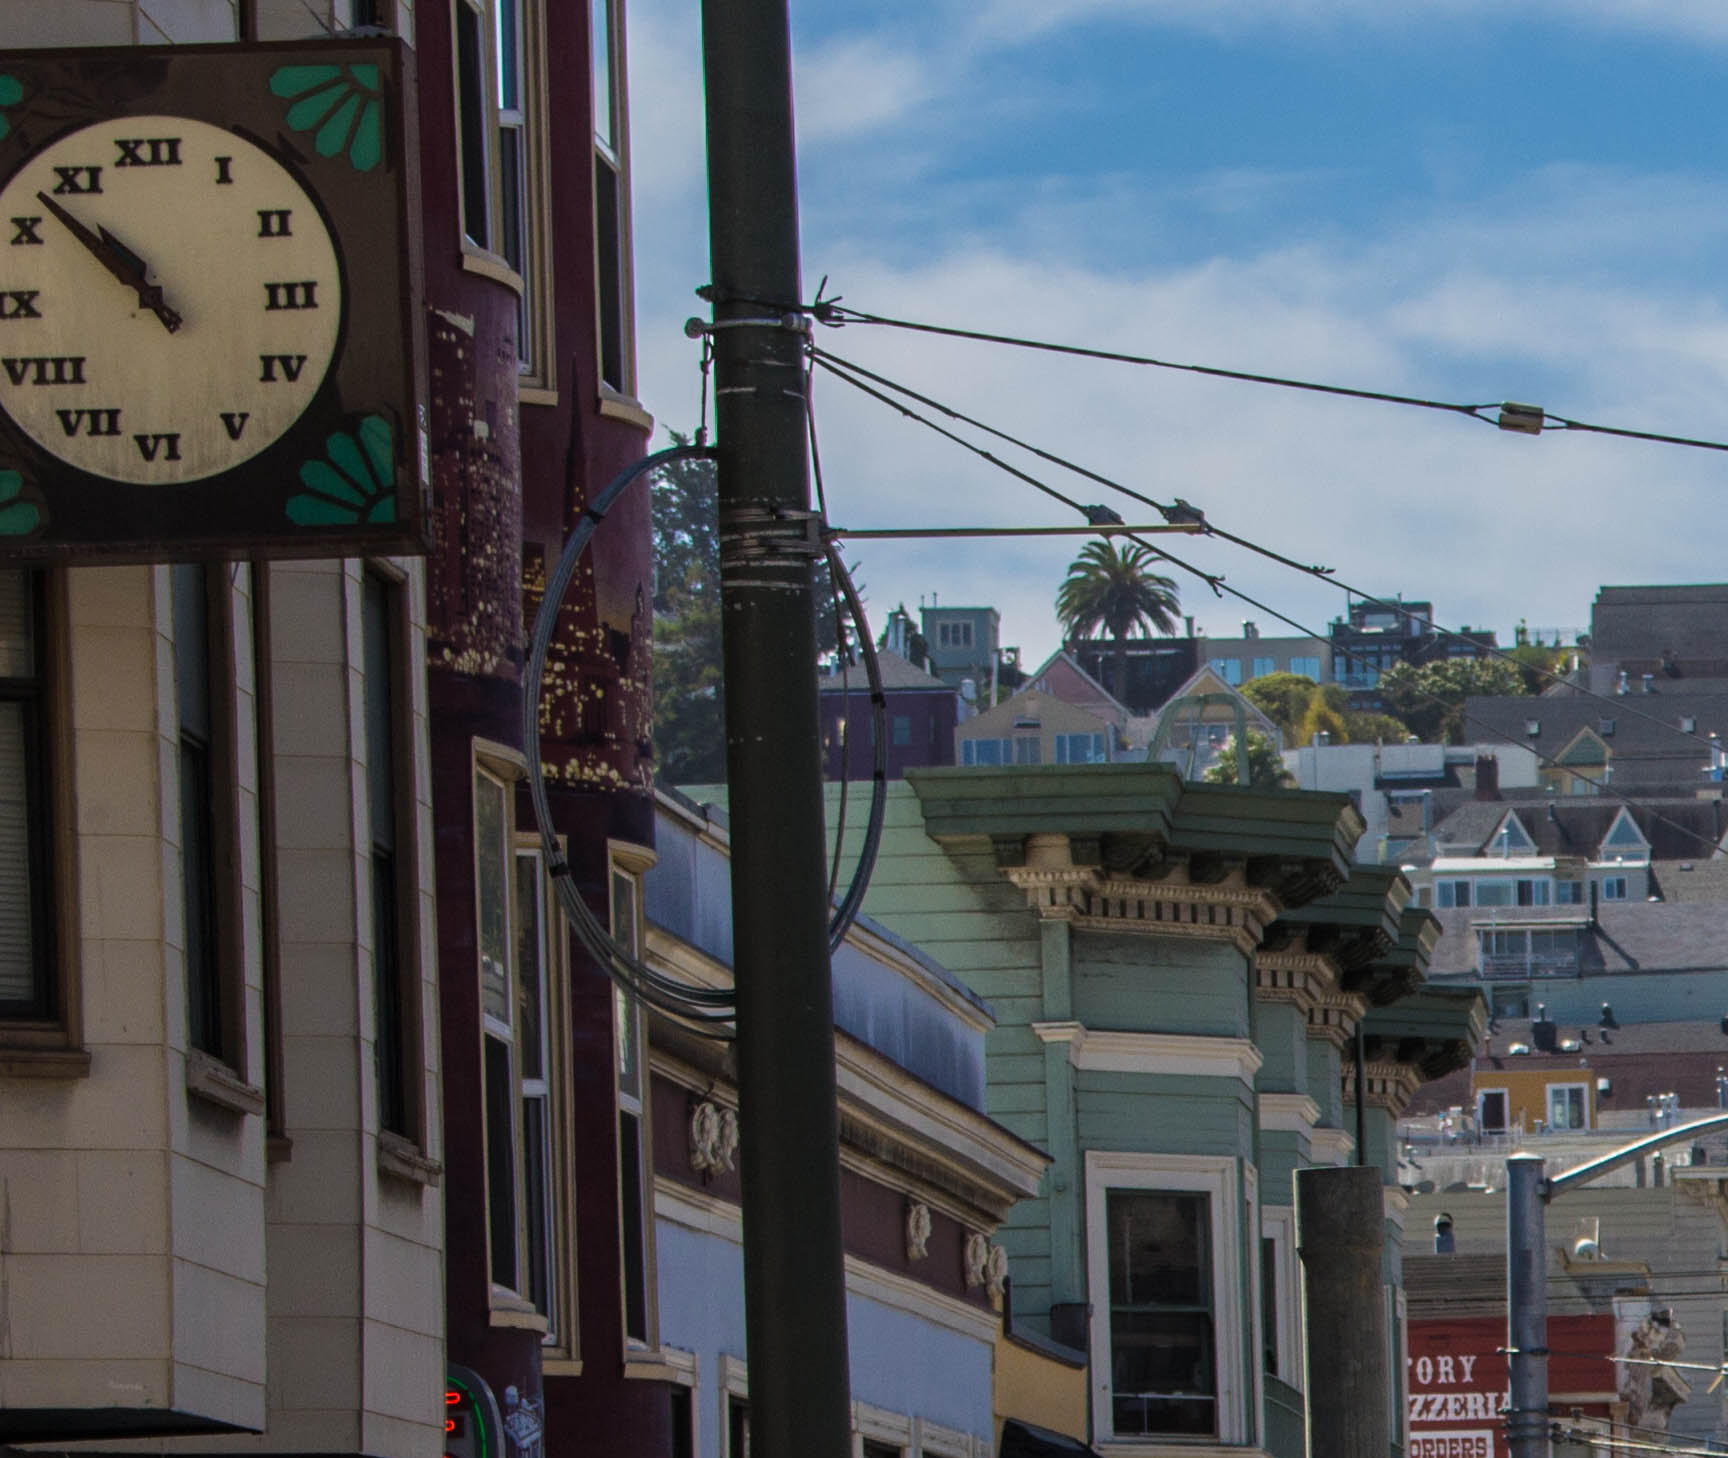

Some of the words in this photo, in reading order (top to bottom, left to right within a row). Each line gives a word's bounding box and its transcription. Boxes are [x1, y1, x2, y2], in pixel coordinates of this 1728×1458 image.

[114, 138, 182, 166] XII
[53, 166, 103, 194] XI
[215, 157, 233, 184] I
[10, 217, 43, 245] X
[257, 209, 292, 237] II
[264, 281, 318, 311] III
[1, 357, 86, 385] VIII
[259, 355, 307, 382] IV
[55, 409, 122, 437] VII
[220, 412, 250, 440] V
[133, 433, 182, 462] VI
